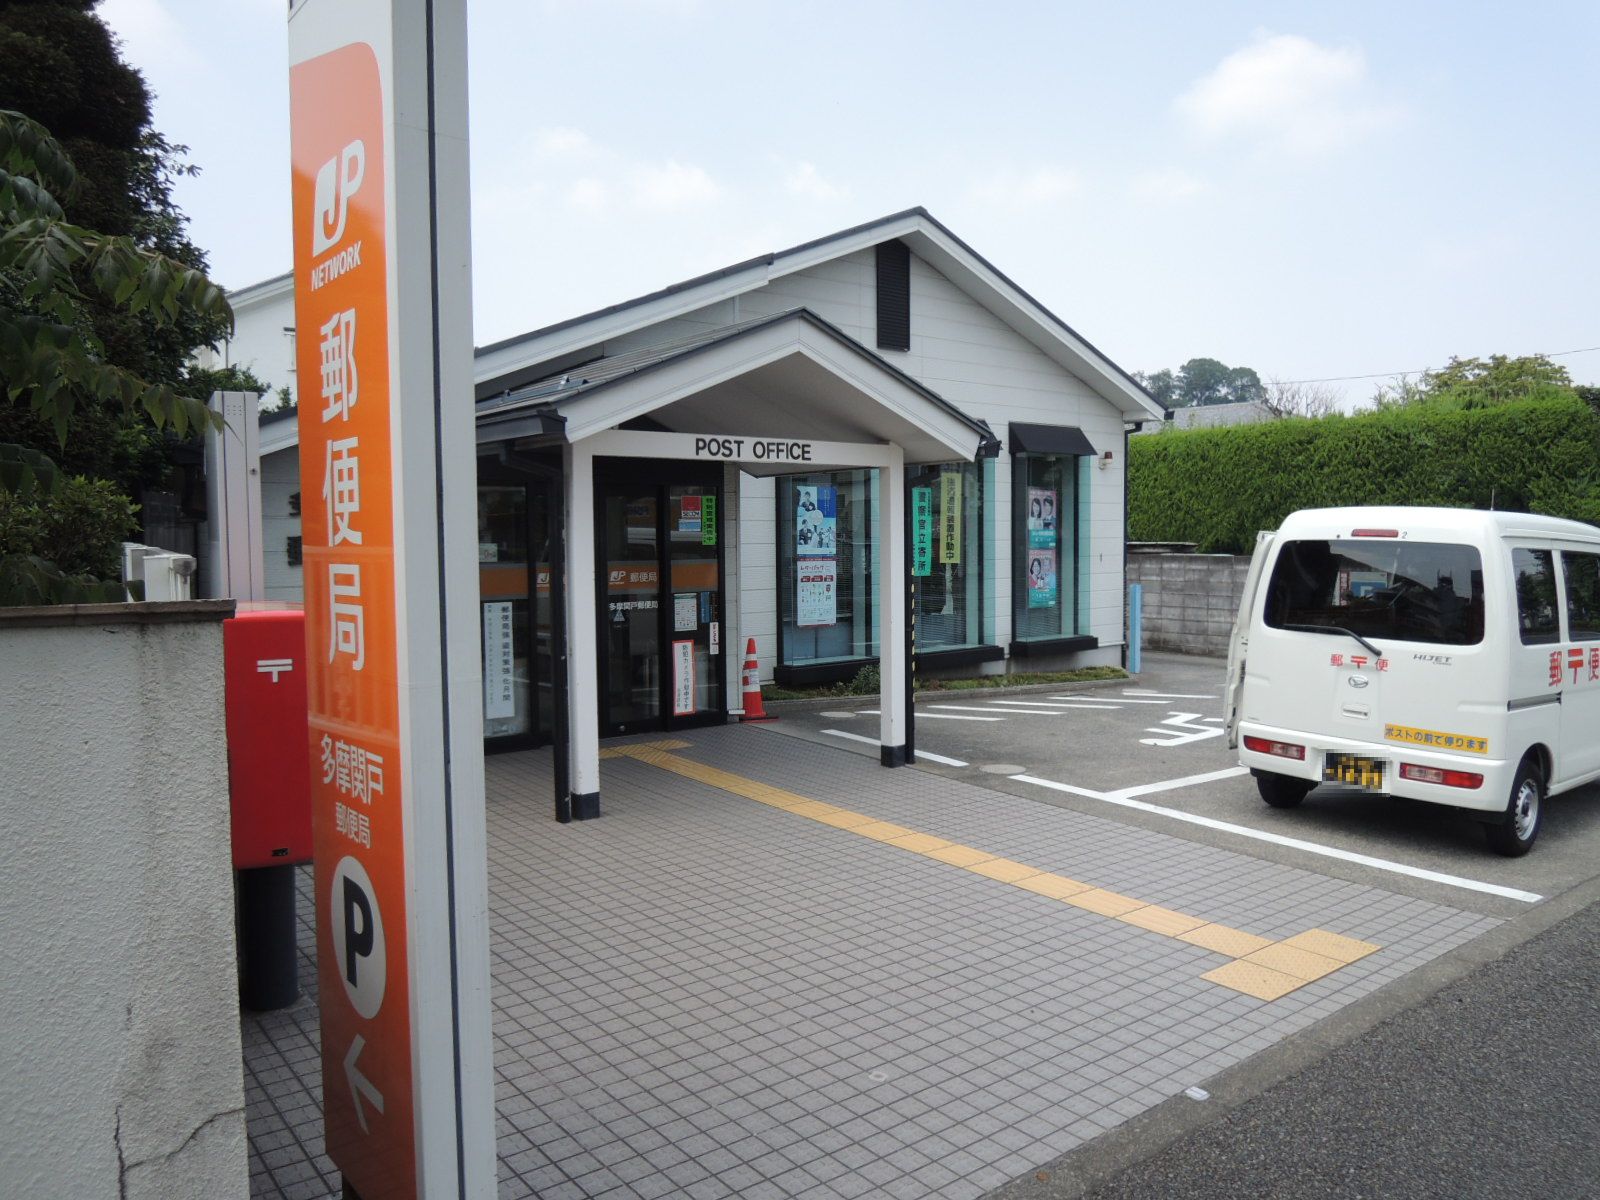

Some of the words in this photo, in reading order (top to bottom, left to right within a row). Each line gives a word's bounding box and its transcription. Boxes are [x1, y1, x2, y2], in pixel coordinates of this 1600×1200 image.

[311, 240, 362, 292] NETWORK
[695, 437, 745, 458] POST
[752, 440, 812, 461] OFFICE
[320, 307, 365, 671] 郵便局
[629, 571, 657, 583] 郵便局
[608, 600, 659, 611] 多摩関戸郵便局
[1413, 653, 1452, 663] HIJET
[320, 733, 384, 806] 多摩関戸
[335, 802, 371, 849] 郵便局
[343, 875, 374, 989] P
